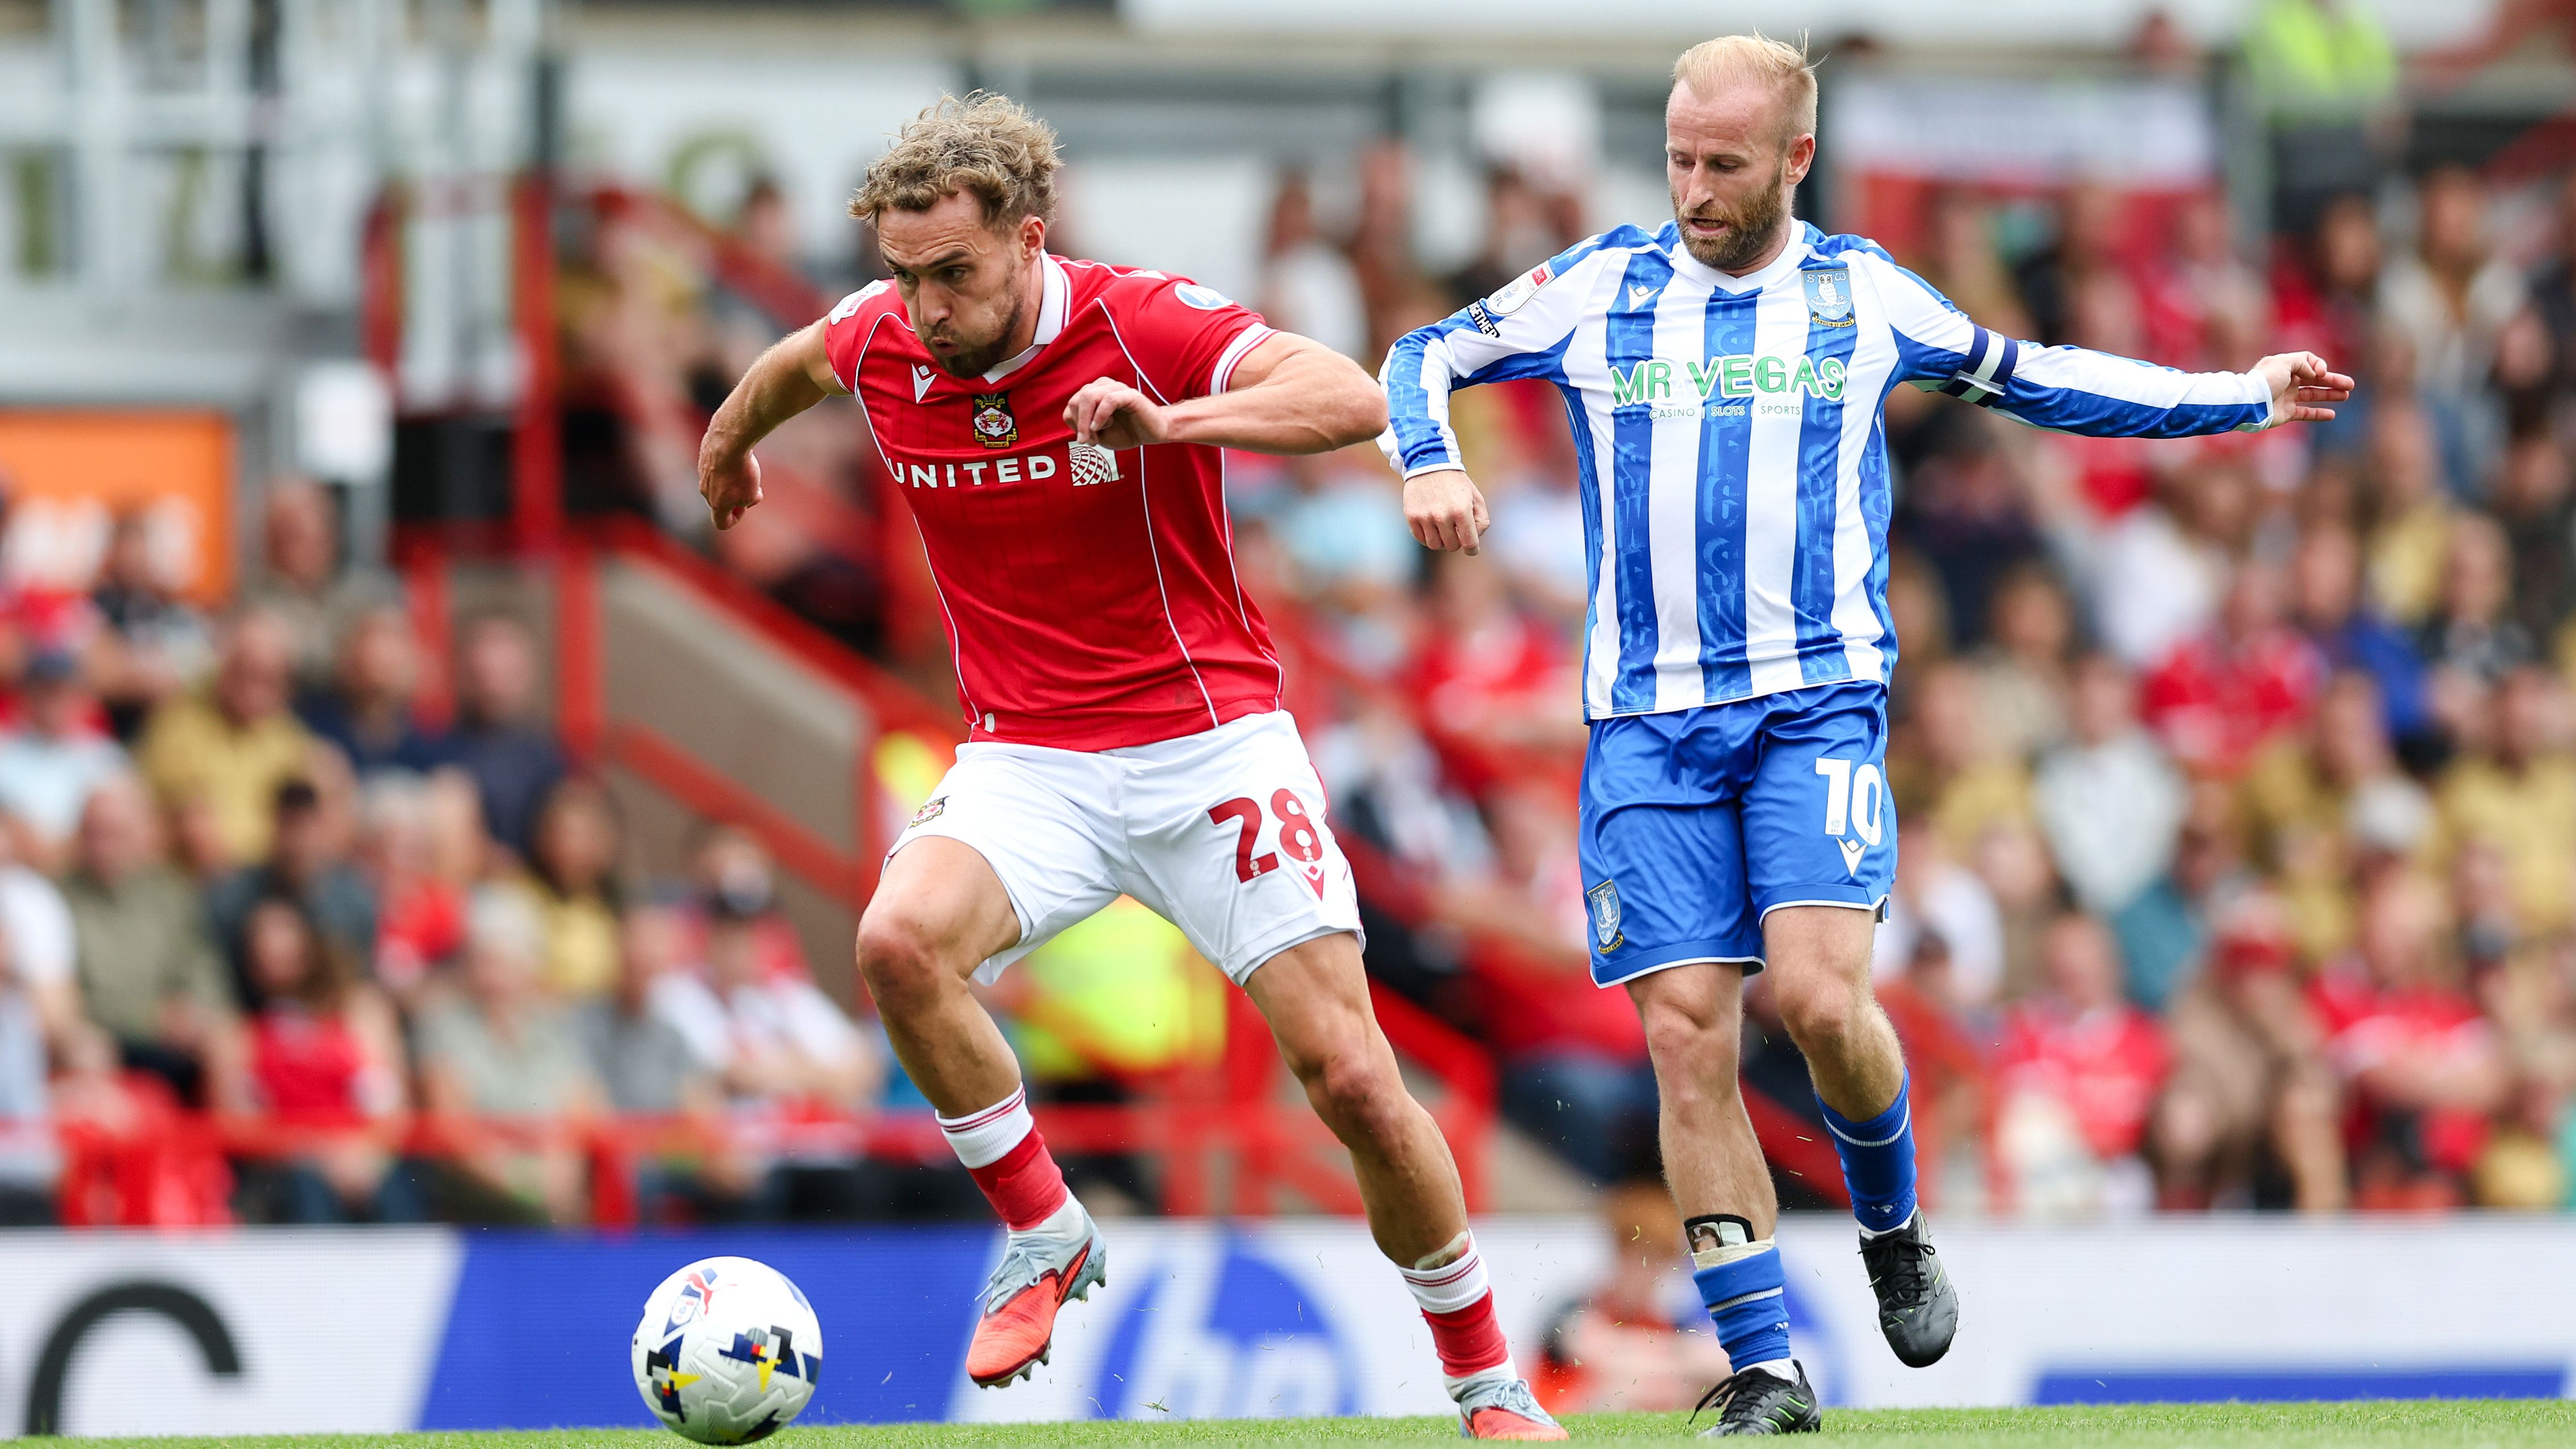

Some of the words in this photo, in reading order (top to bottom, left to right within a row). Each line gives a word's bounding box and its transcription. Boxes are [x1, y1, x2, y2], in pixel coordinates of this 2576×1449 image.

[1612, 362, 1671, 404] MR
[1687, 356, 1844, 398] VEGAS
[1650, 408, 1695, 419] CASINO
[1711, 406, 1745, 417] SLOTS
[1761, 405, 1801, 415] SPORTS
[888, 455, 1055, 488] UNITED
[1815, 757, 1882, 846] 10
[1207, 788, 1323, 884] 28
